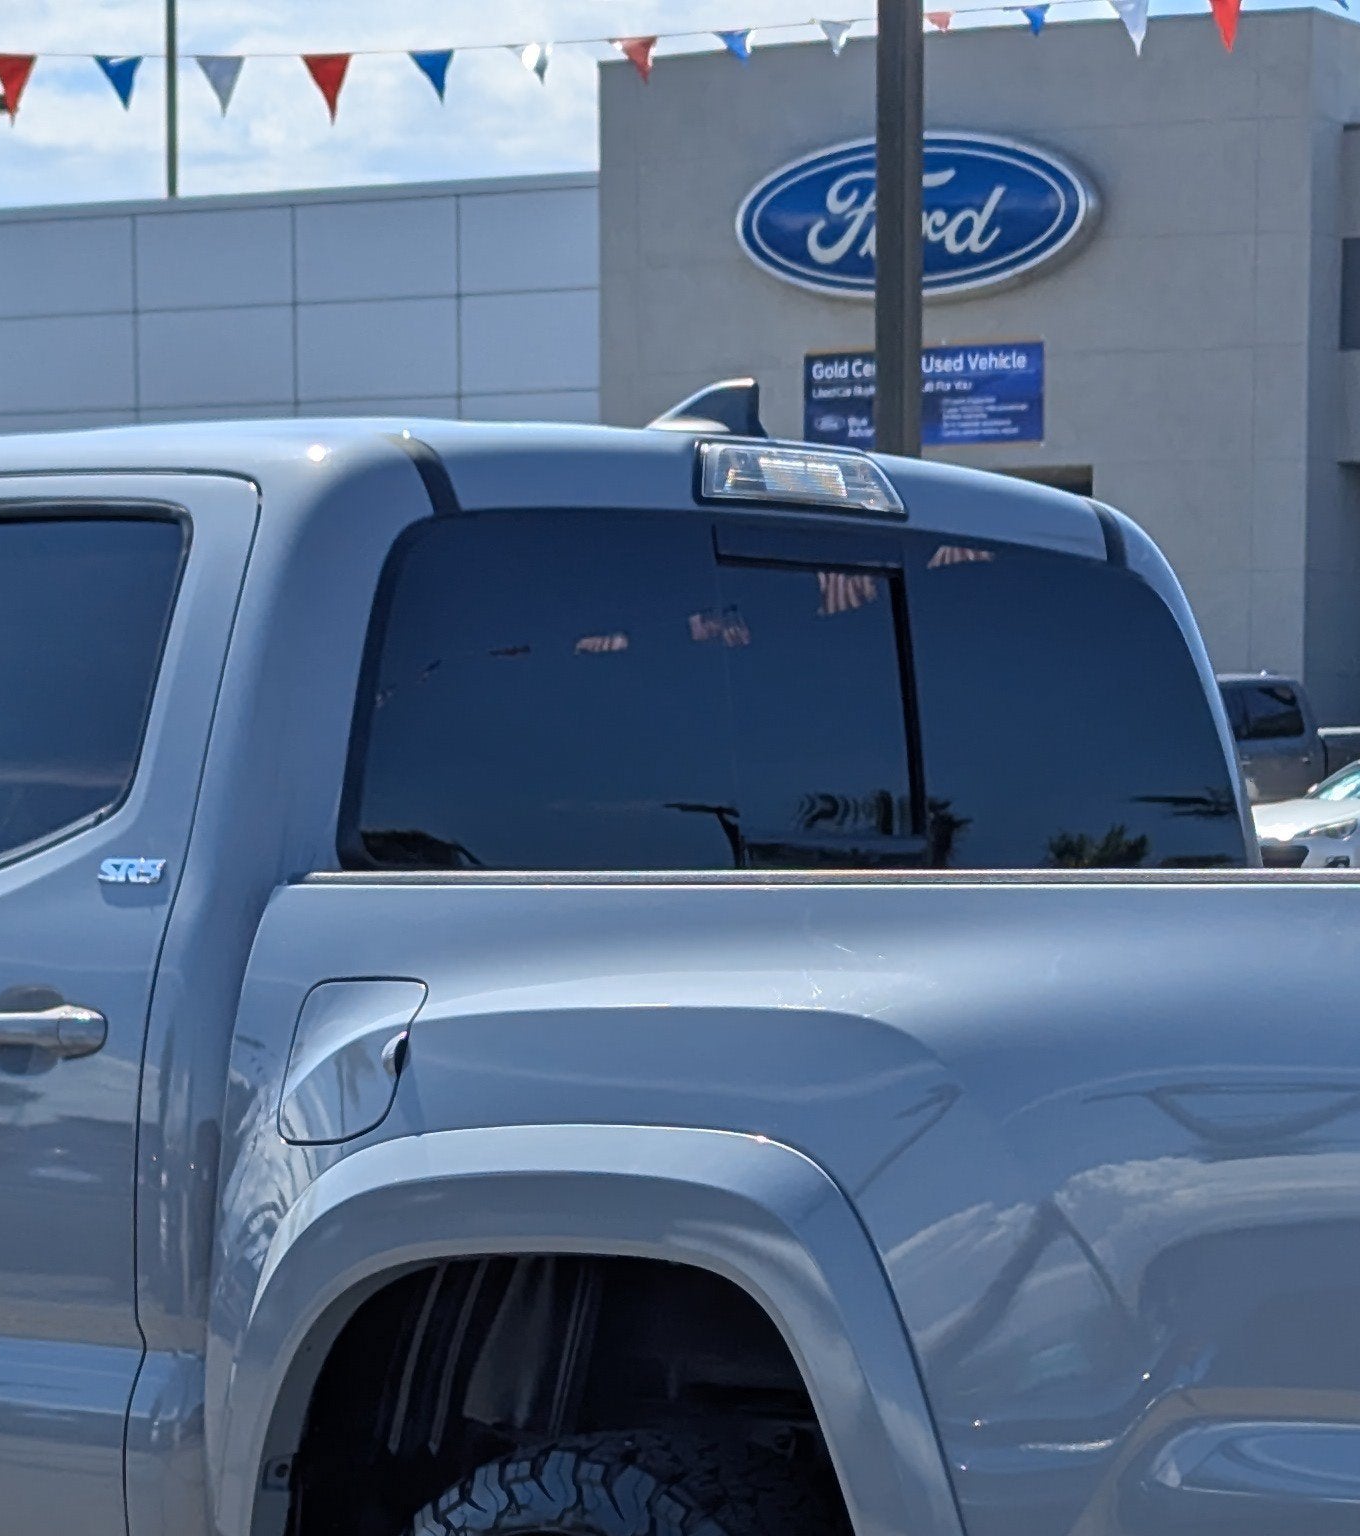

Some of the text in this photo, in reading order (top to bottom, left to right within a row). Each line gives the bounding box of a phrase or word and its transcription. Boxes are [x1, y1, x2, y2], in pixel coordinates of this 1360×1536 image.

[807, 167, 1006, 265] Frd
[812, 358, 848, 380] Gold
[921, 352, 964, 374] Used
[967, 350, 1027, 371] Vehicle
[97, 857, 167, 883] SR5
